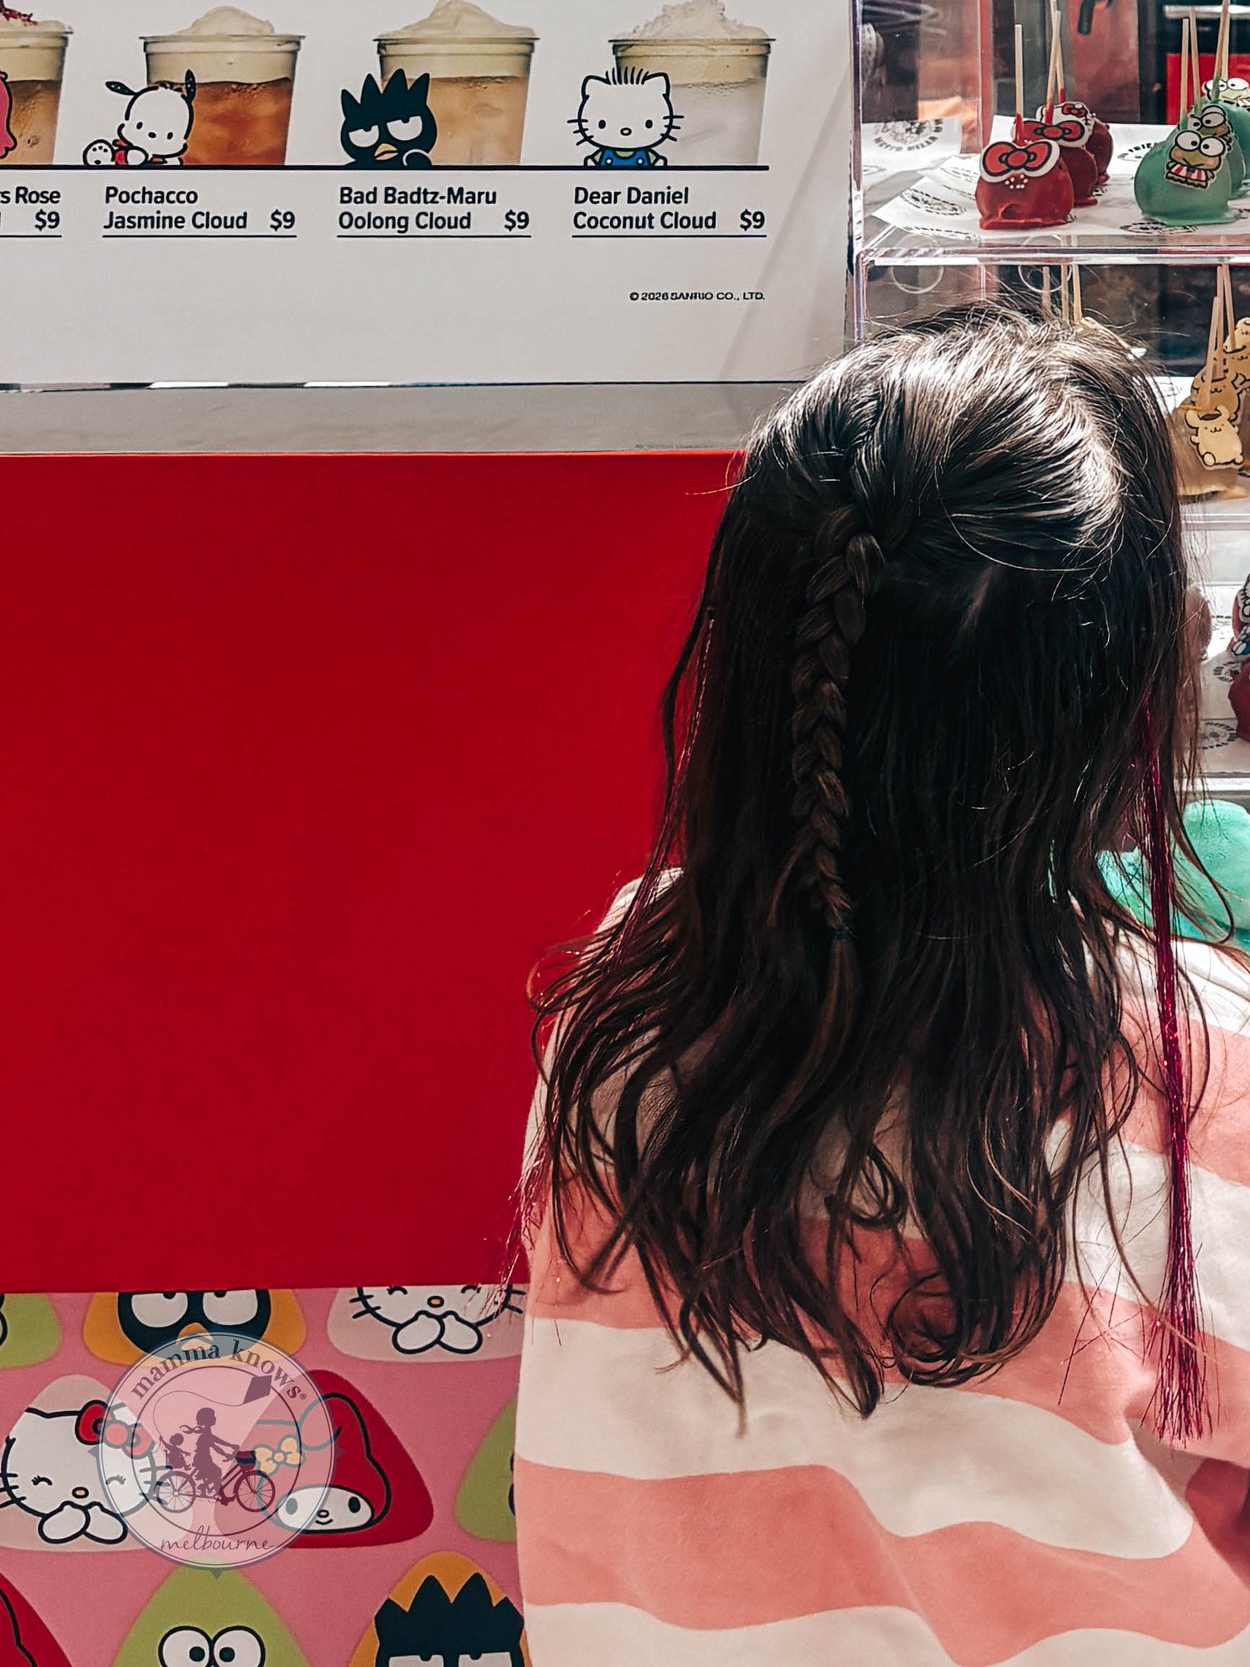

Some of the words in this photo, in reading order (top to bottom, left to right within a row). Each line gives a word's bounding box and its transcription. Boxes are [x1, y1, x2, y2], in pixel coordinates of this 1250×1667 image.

[15, 186, 61, 204] Rose
[105, 186, 198, 204] Pochacco
[339, 186, 378, 204] Bad
[384, 186, 497, 204] Badtz-Maru
[574, 186, 621, 204] Dear
[627, 185, 689, 204] Daniel
[34, 208, 61, 231] $9
[103, 210, 186, 229] Jasmine
[191, 211, 248, 229] Cloud
[269, 209, 296, 231] $9
[338, 211, 409, 234] Oolong
[415, 211, 471, 229] Cloud
[504, 209, 530, 232] $9
[573, 211, 655, 229] Coconut
[660, 211, 717, 229] Cloud
[739, 208, 767, 231] $9
[743, 292, 766, 301] LTD.
